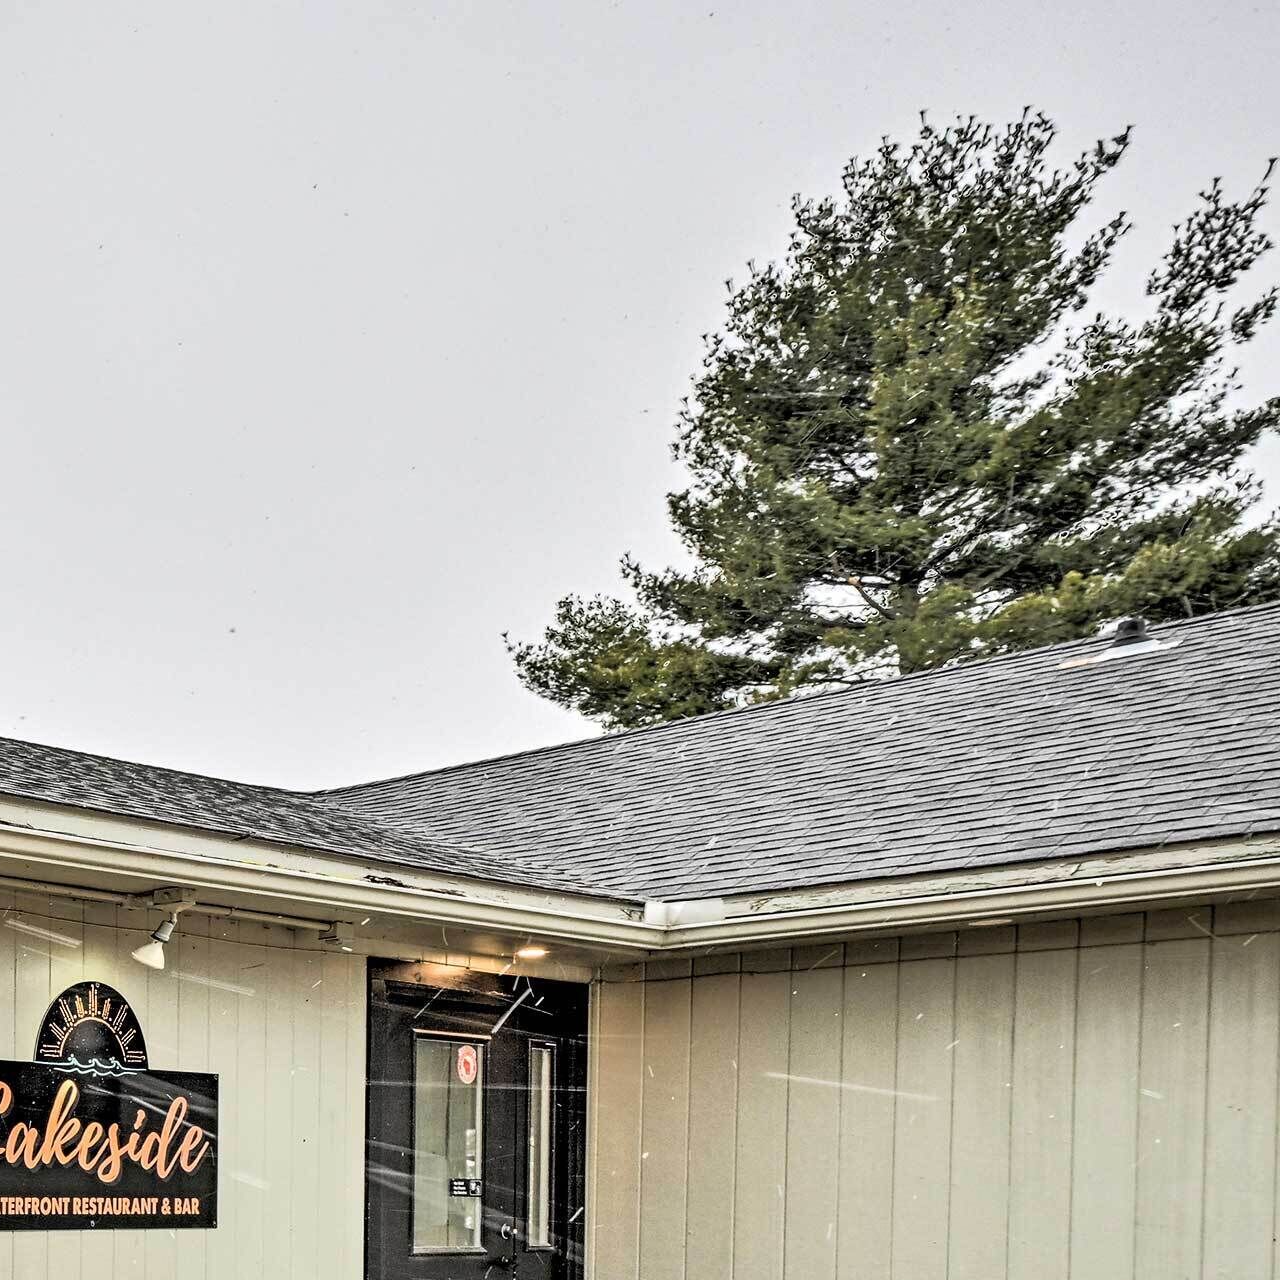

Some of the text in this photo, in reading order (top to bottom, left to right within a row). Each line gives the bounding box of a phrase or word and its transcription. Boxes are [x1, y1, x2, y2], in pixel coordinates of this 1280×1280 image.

[72, 1197, 158, 1215] RESTAURANT
[161, 1197, 171, 1215] &
[174, 1197, 200, 1215] BAR
